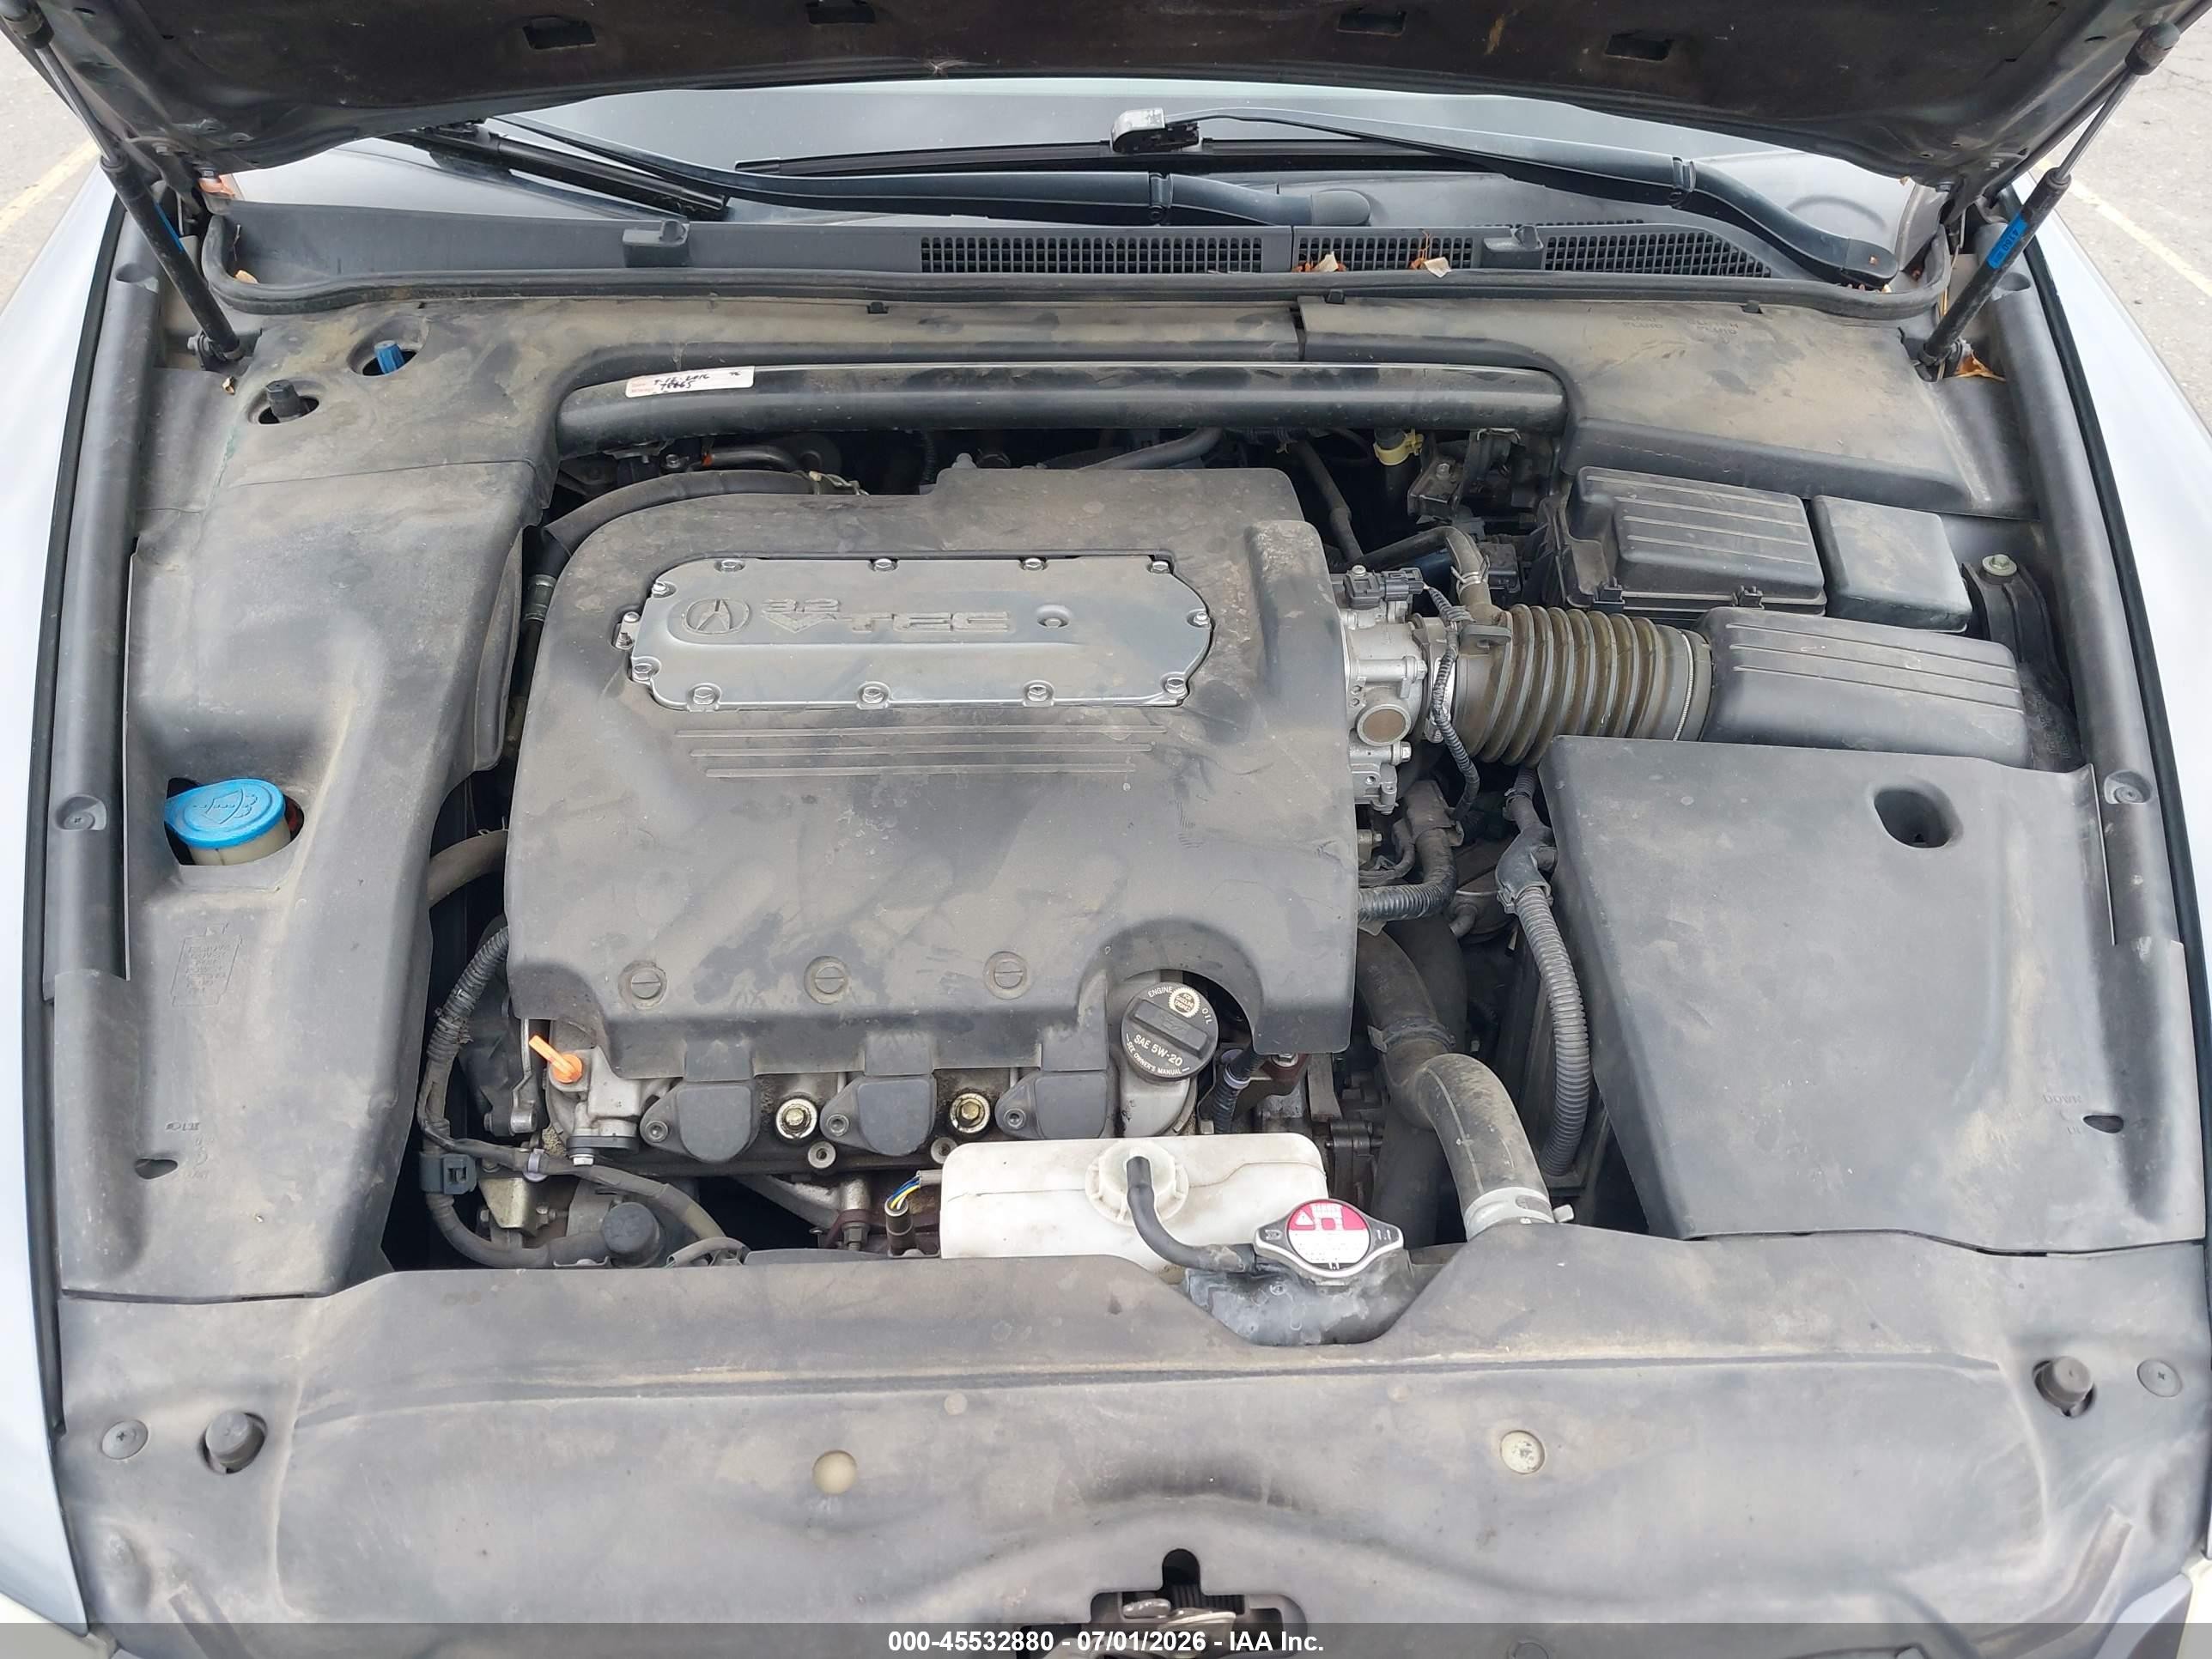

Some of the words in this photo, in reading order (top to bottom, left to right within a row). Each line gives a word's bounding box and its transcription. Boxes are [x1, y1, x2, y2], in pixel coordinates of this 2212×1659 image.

[761, 611, 1013, 634] VTEC
[1147, 986, 1174, 998] ENGINE
[1201, 1007, 1213, 1024] OIL
[1127, 1042, 1136, 1054] SEE
[1133, 1052, 1157, 1072] OWNER'S
[1158, 1067, 1182, 1076] MANUAL
[1133, 1034, 1152, 1049] SAE
[1151, 1044, 1183, 1066] 5W-20
